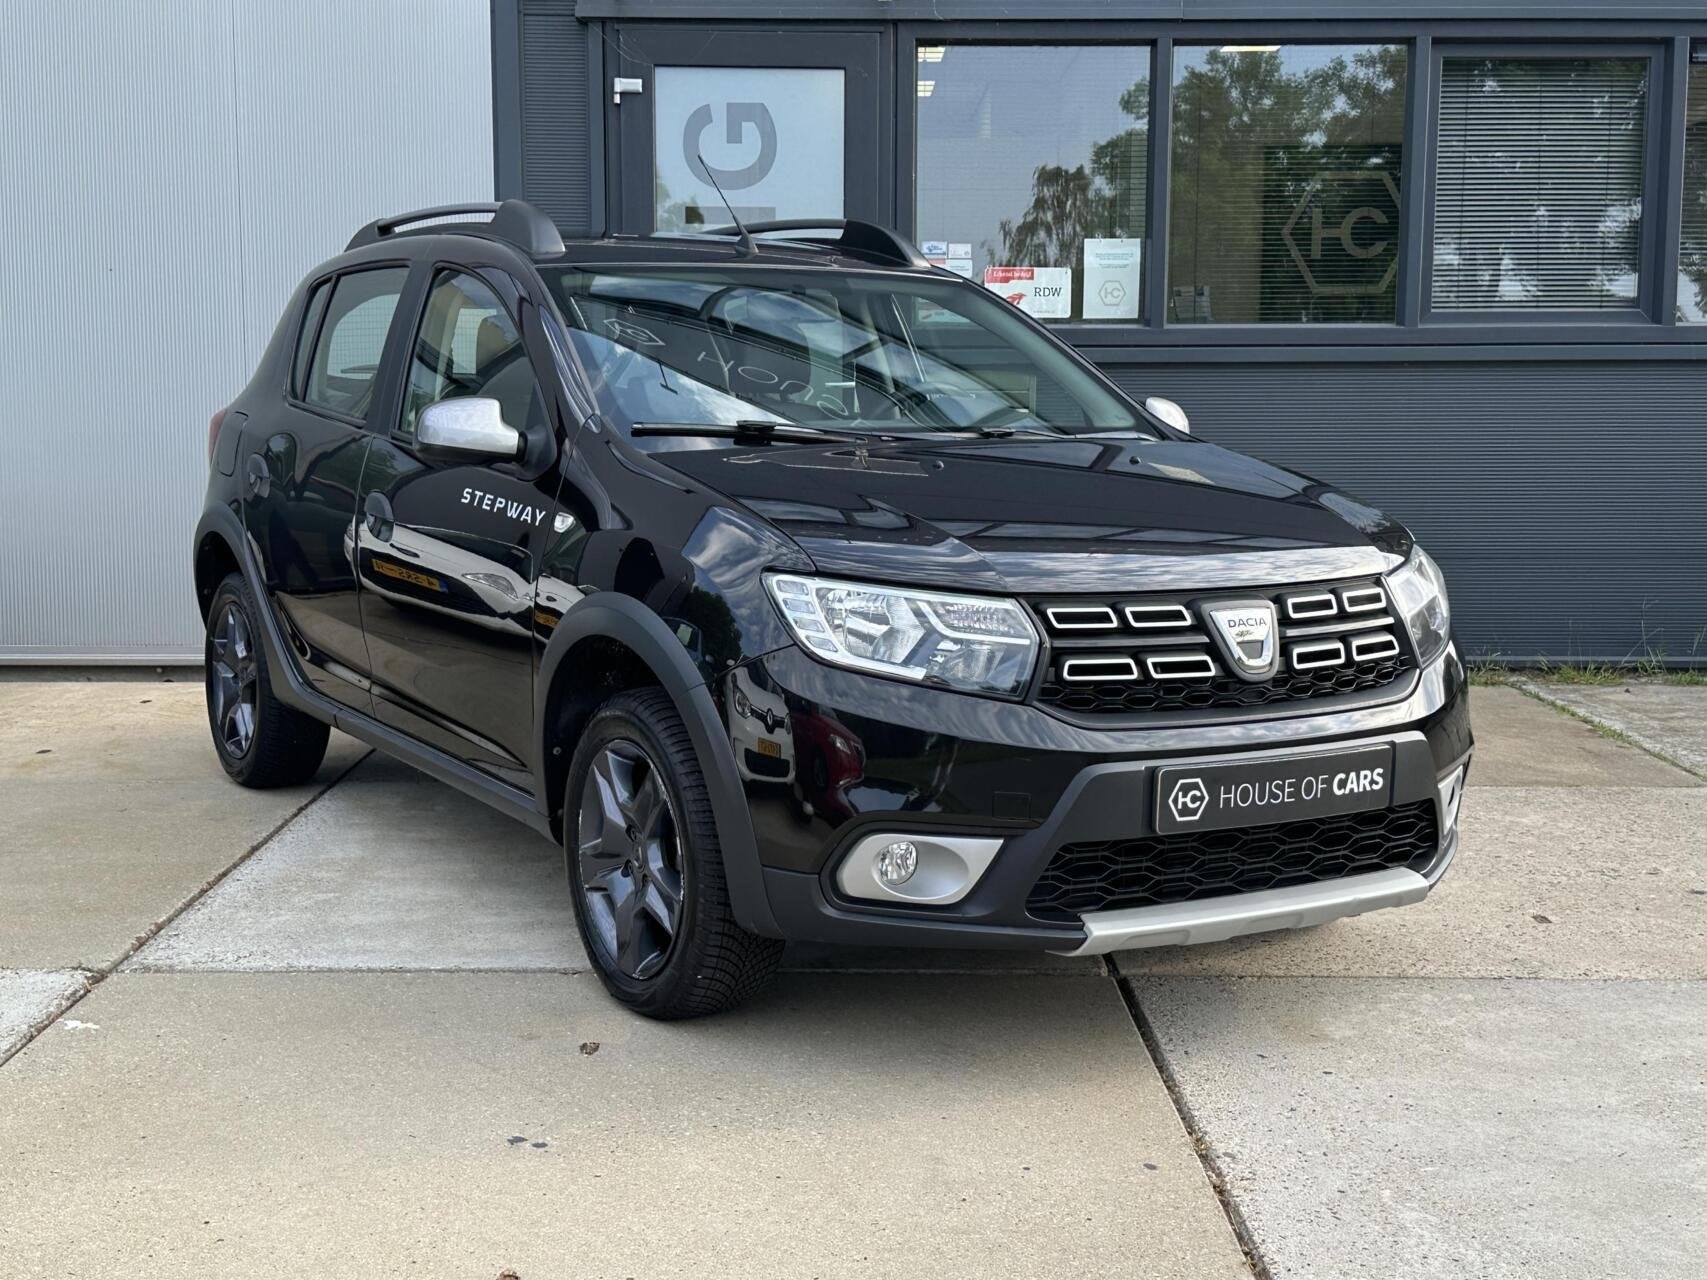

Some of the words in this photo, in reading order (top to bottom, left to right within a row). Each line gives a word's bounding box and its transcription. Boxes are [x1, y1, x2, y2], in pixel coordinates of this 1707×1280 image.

[1034, 286, 1063, 298] RDW
[461, 487, 546, 526] STEPWAY
[1227, 617, 1267, 628] DACIA
[1219, 778, 1297, 809] HOUSE
[1301, 775, 1329, 800] OF
[1332, 767, 1384, 796] CARS
